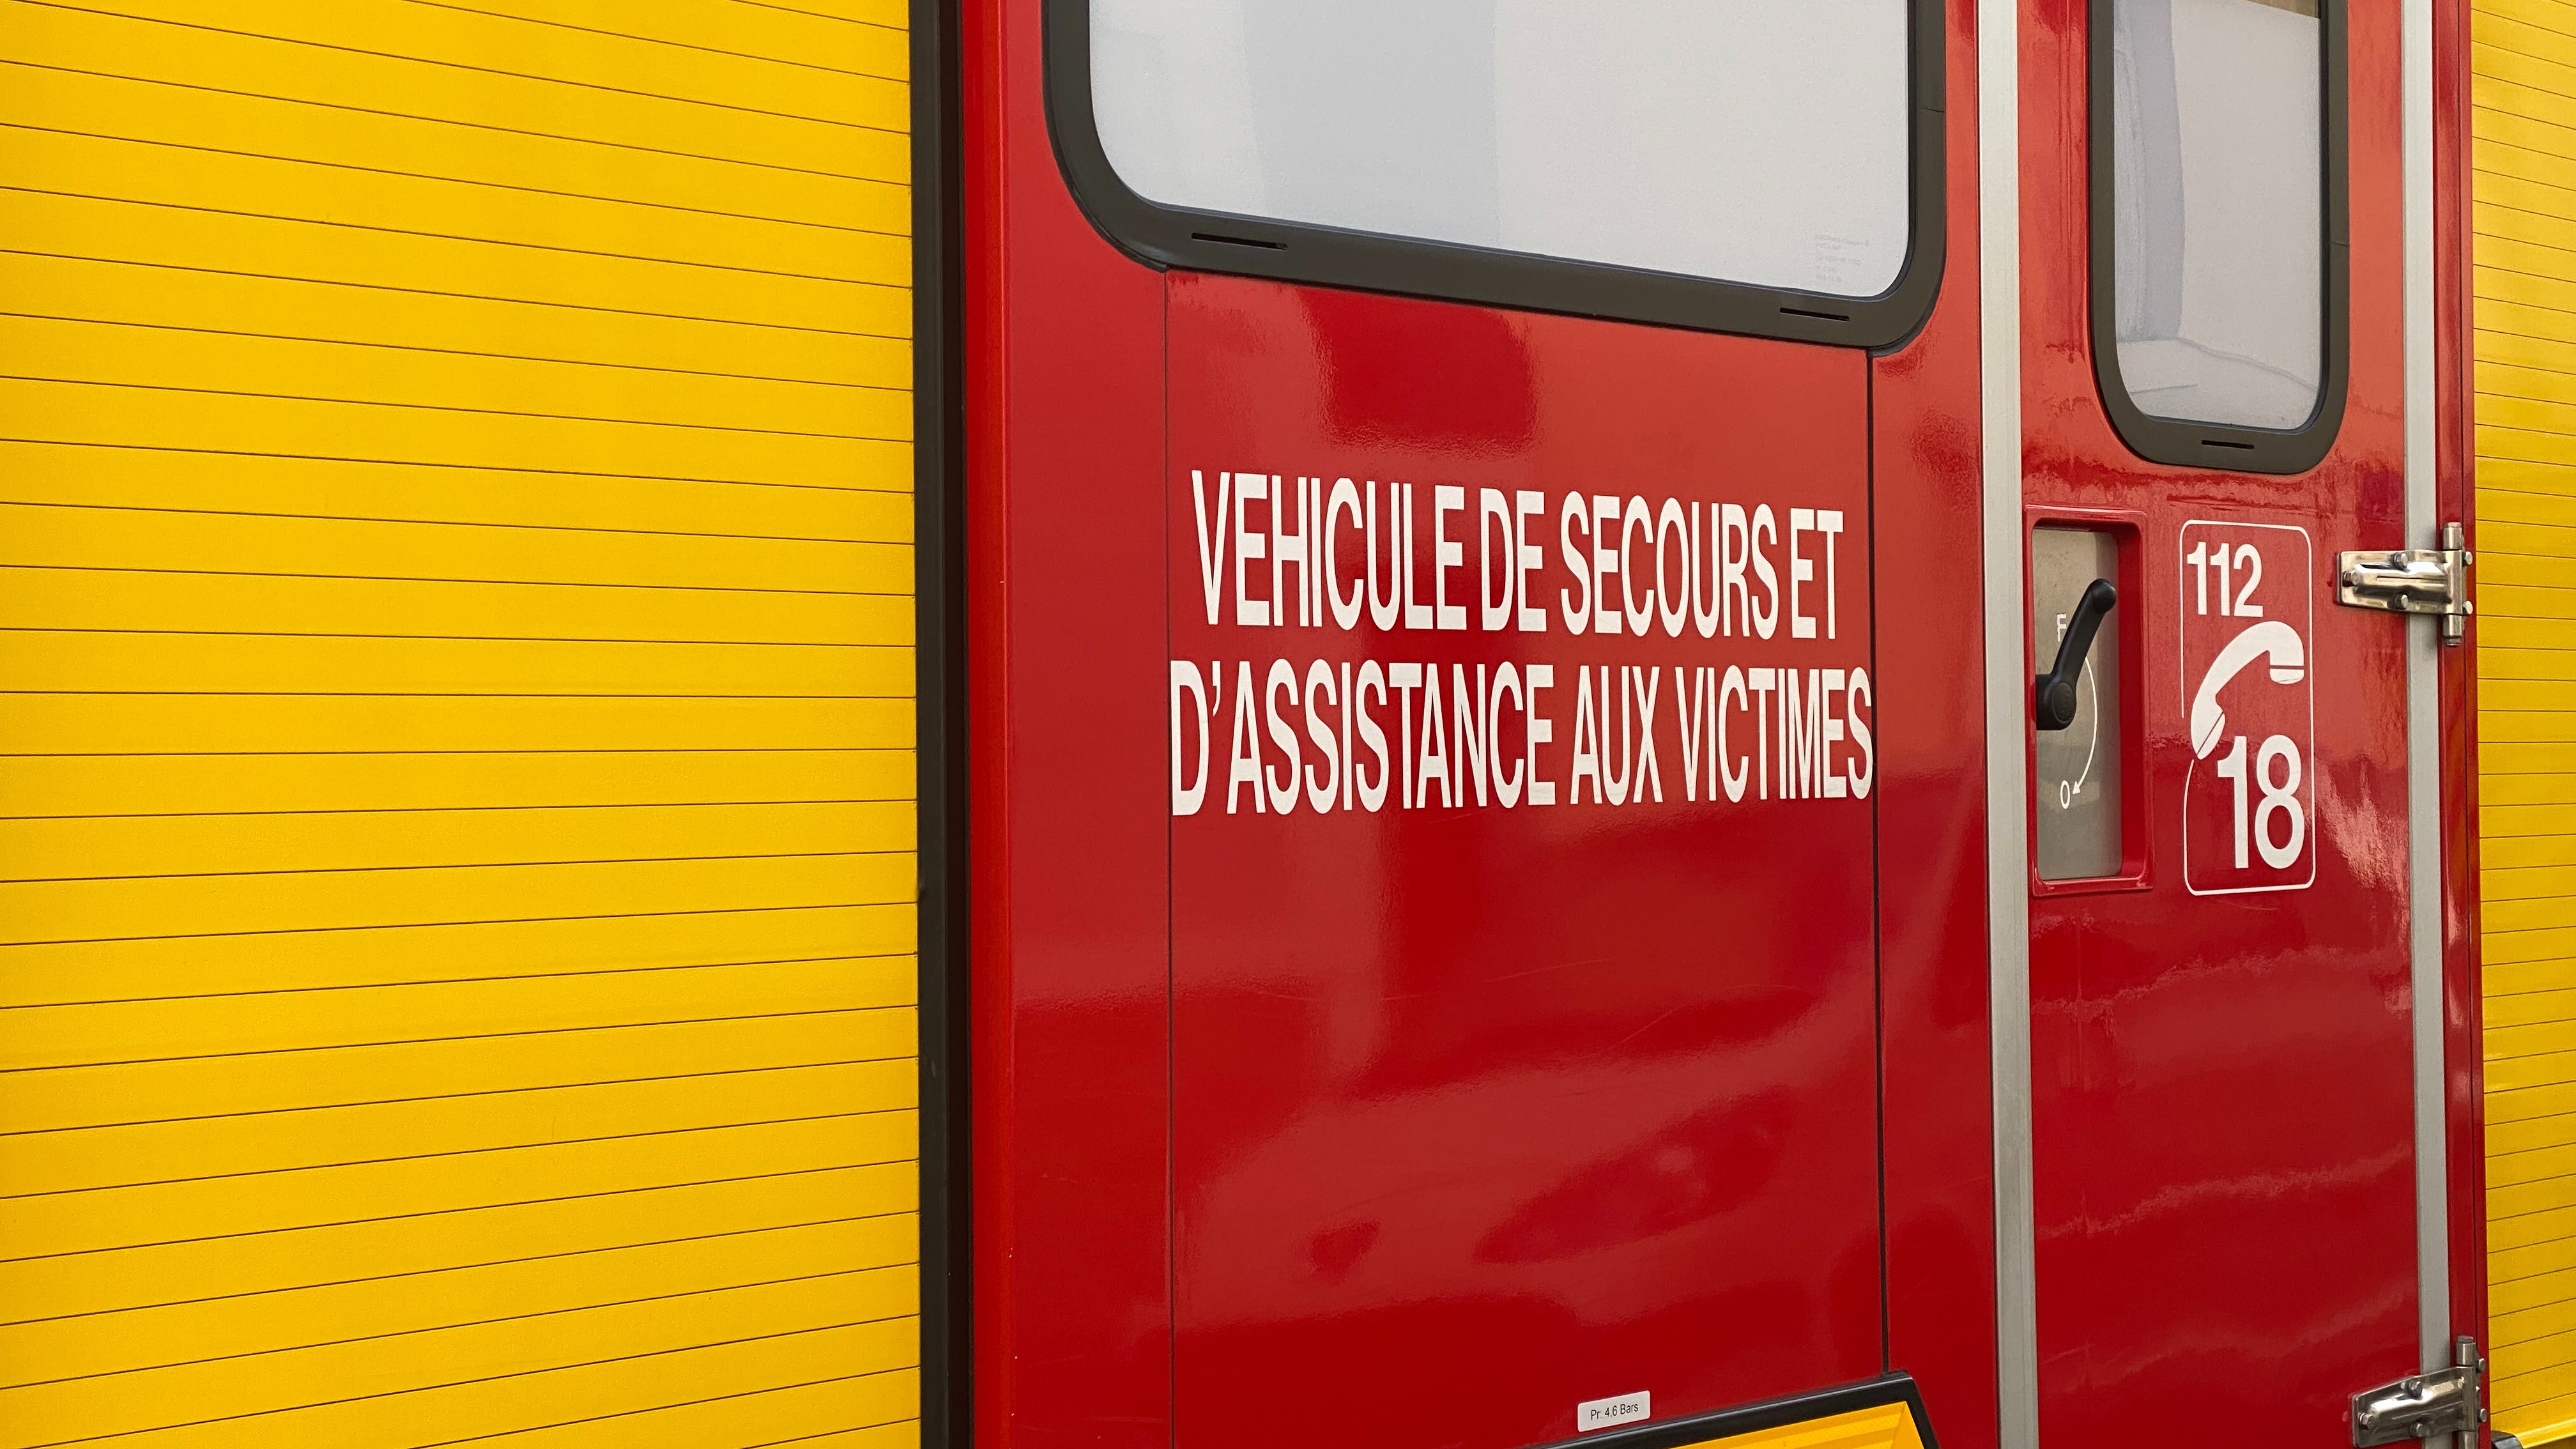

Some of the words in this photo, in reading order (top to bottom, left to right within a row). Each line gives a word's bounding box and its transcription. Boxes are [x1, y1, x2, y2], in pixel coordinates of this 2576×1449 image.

[1191, 469, 1468, 631] VEHICULE
[1480, 487, 1547, 632] DE
[1560, 491, 1779, 640] SECOURS
[1790, 507, 1844, 640] ET
[2187, 541, 2264, 617] 112
[2057, 613, 2067, 643] F
[1170, 659, 1556, 816] D'ASSISTANCE
[1570, 665, 1664, 806] AUX
[1675, 664, 1873, 803] VICTIMES
[2217, 734, 2305, 870] 18
[1604, 1405, 1618, 1418] 4,6
[1620, 1404, 1639, 1415] Bars
